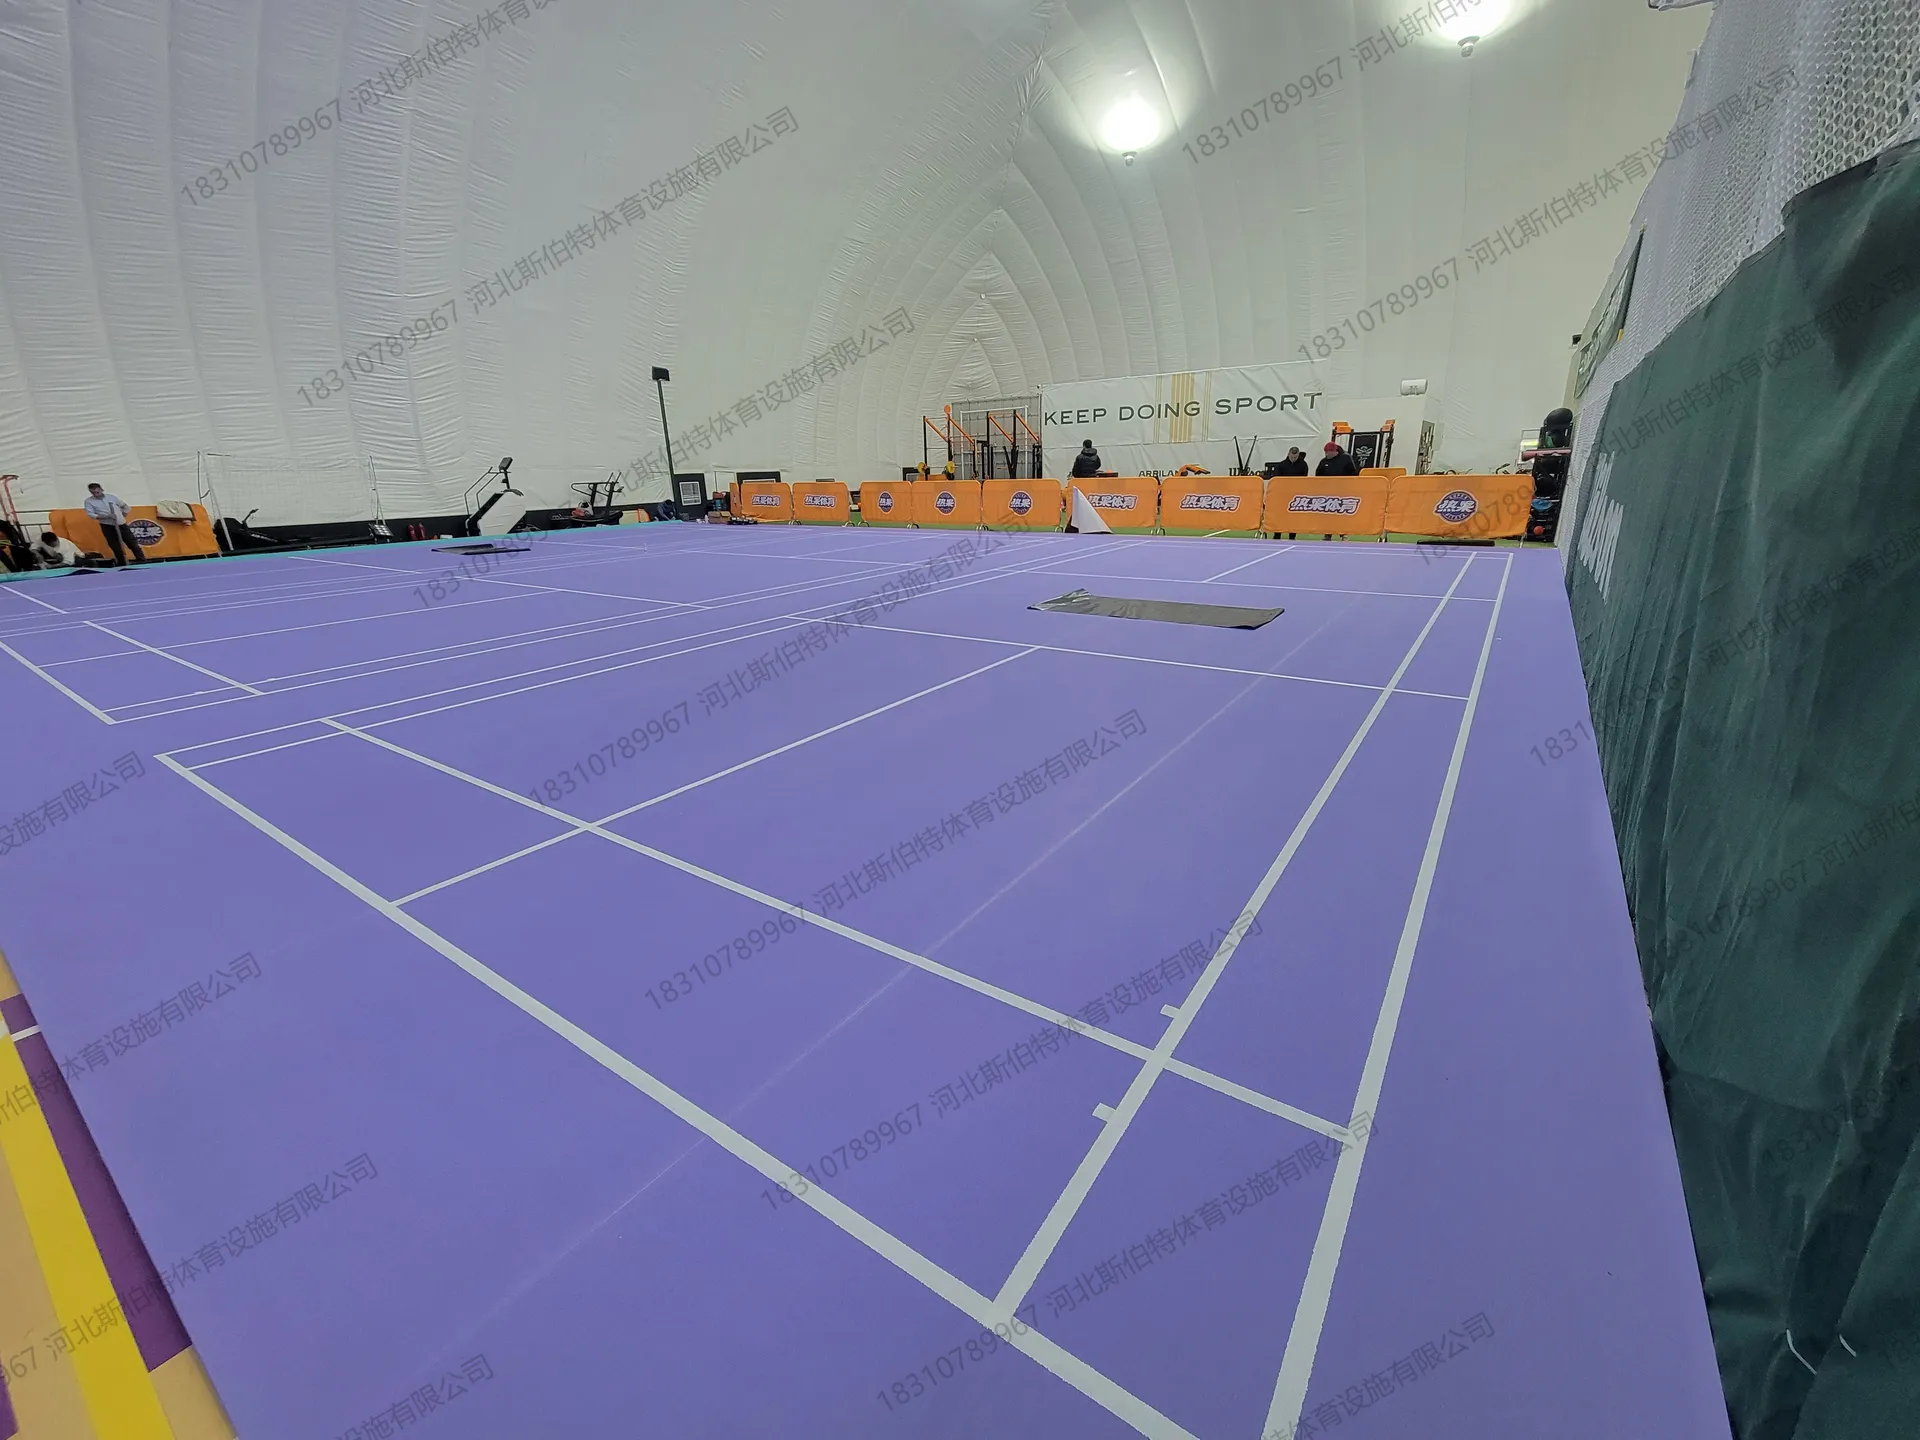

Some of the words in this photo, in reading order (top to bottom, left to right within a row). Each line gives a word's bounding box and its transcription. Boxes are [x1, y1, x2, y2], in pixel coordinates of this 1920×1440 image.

[1044, 407, 1107, 426] KEEP
[1119, 401, 1201, 421] DOING
[1214, 392, 1323, 415] SPORT
